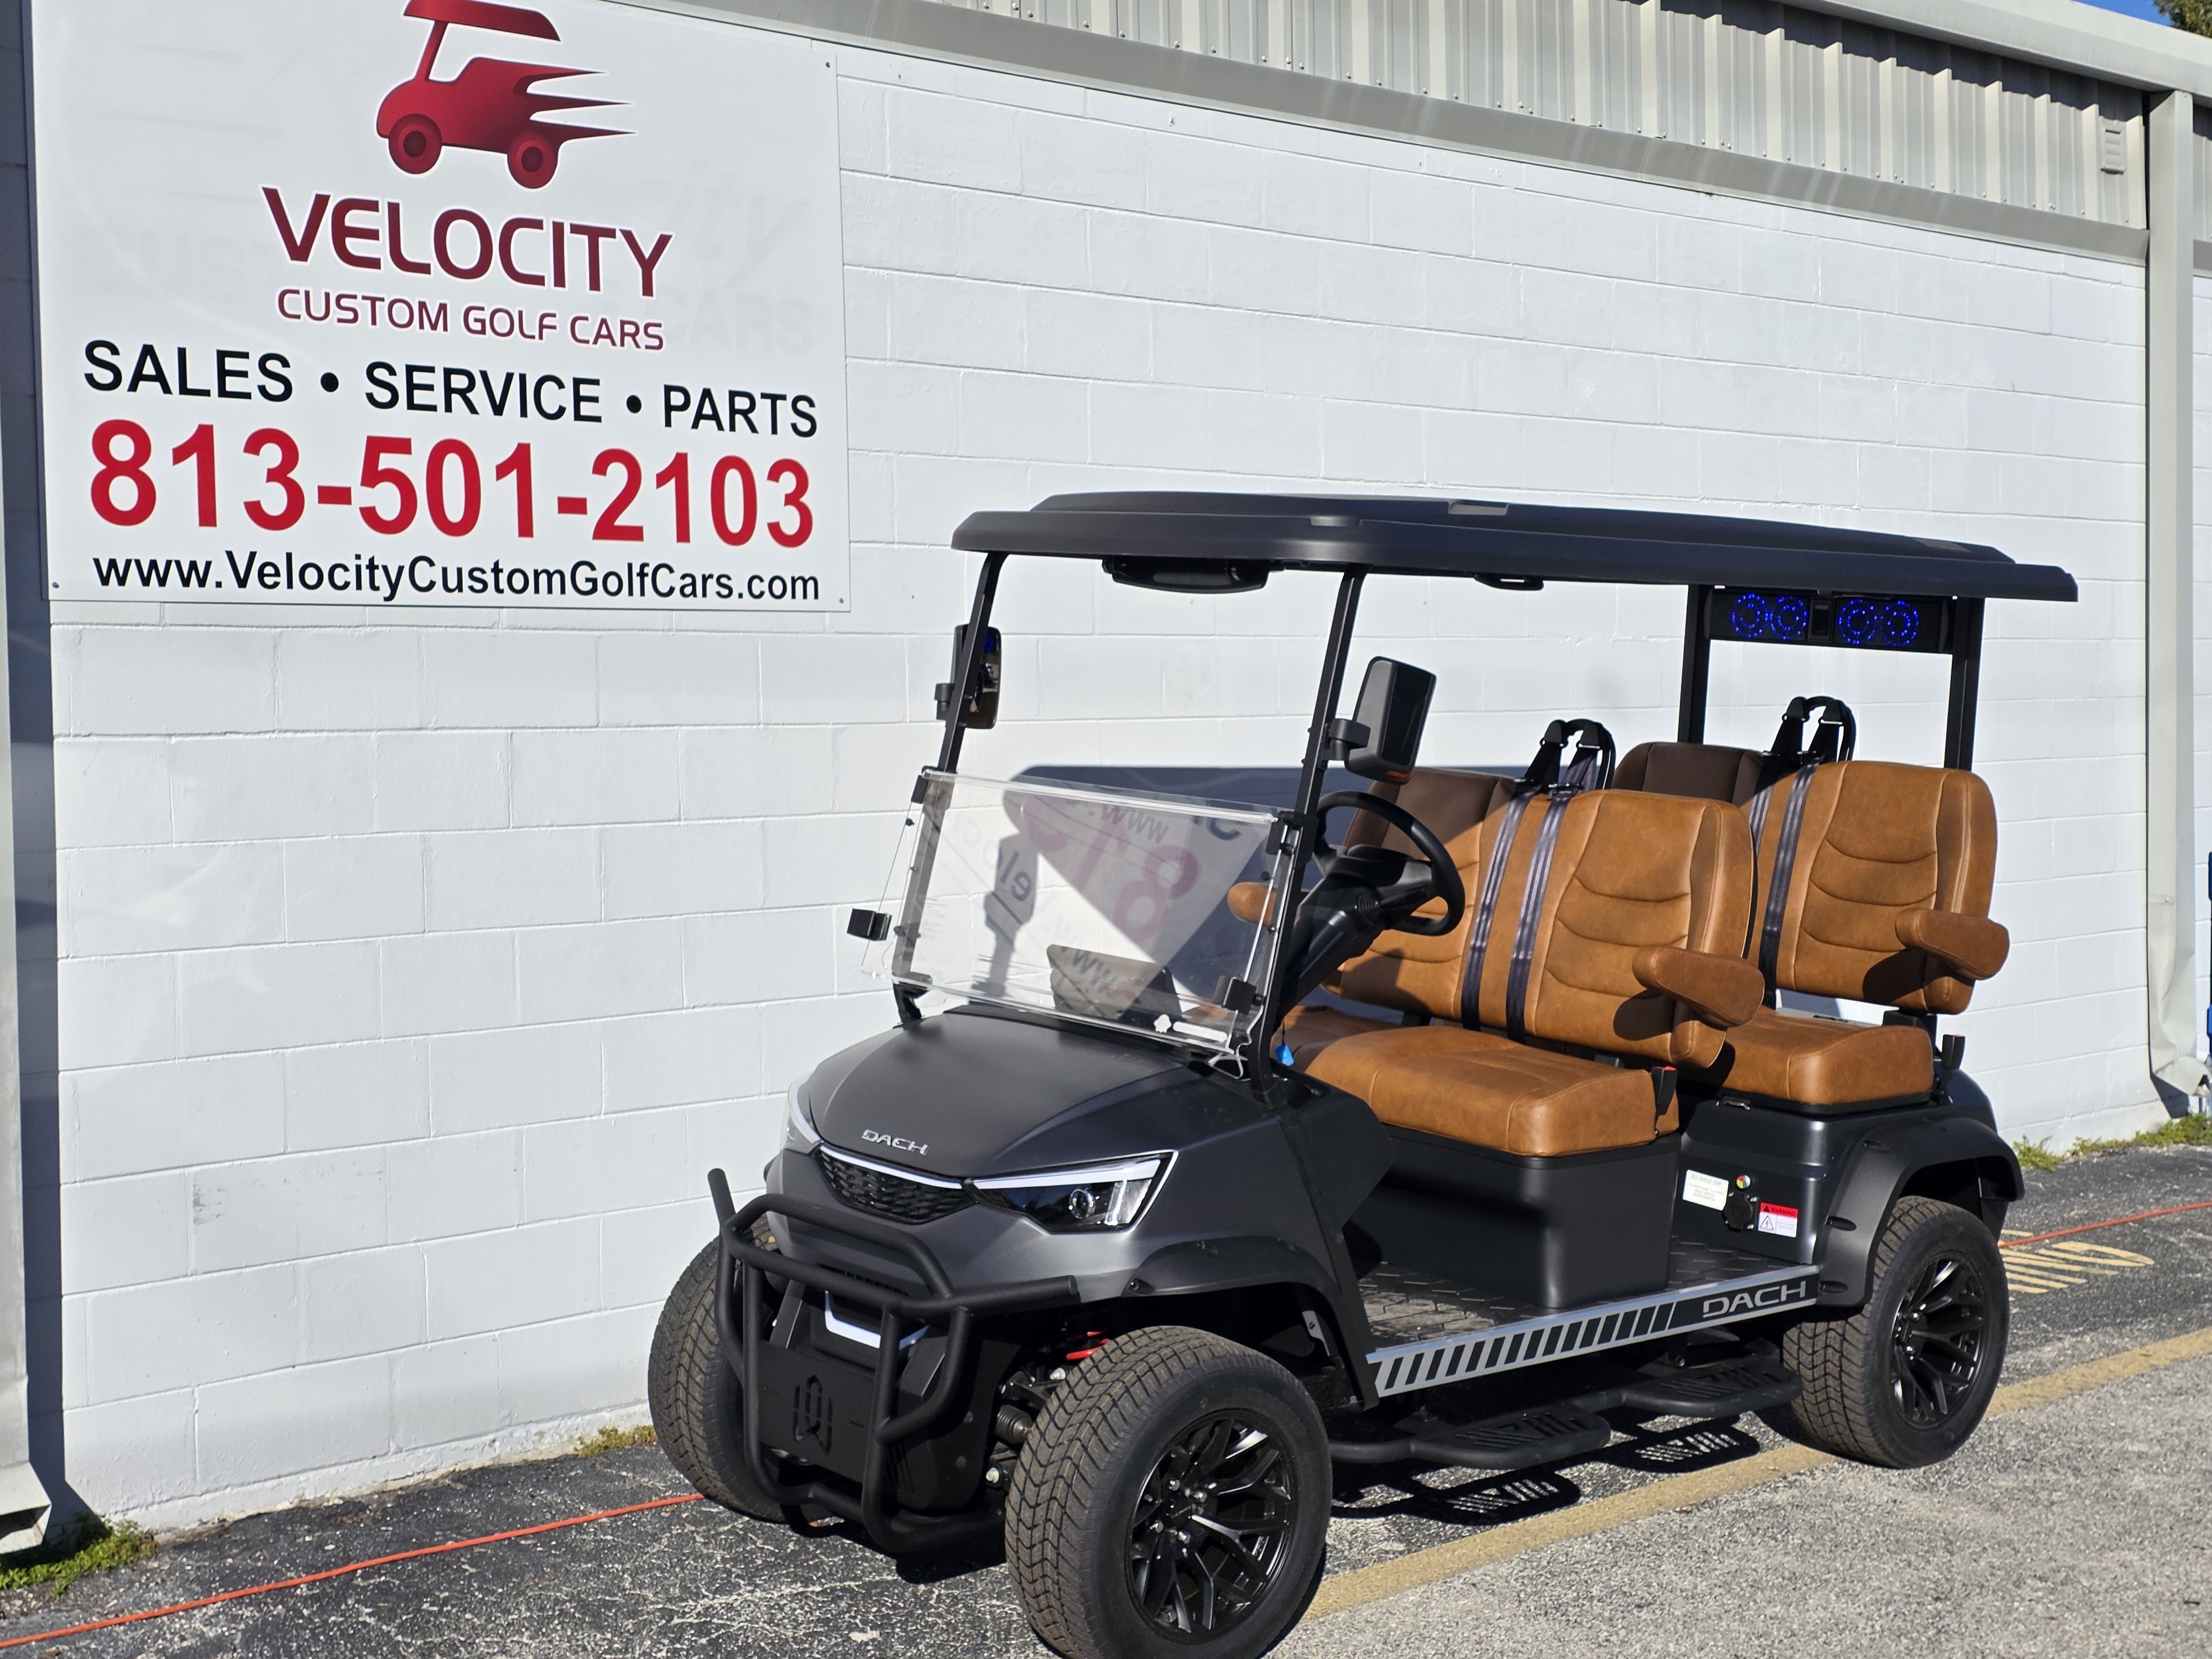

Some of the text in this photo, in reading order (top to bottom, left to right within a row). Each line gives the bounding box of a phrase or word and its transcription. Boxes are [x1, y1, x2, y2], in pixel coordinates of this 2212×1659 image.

[262, 187, 672, 296] VELOCITY
[278, 289, 664, 351] CUSTOM GOLF CARS
[85, 340, 817, 438] SALES SERVICE PARTS
[91, 419, 813, 548] 813-501-2103
[93, 550, 819, 604] www.VelocityCustomGolfCars.com
[861, 1129, 928, 1156] DACH
[1771, 1207, 1796, 1217] WARNING
[1703, 1281, 1807, 1318] DACH
